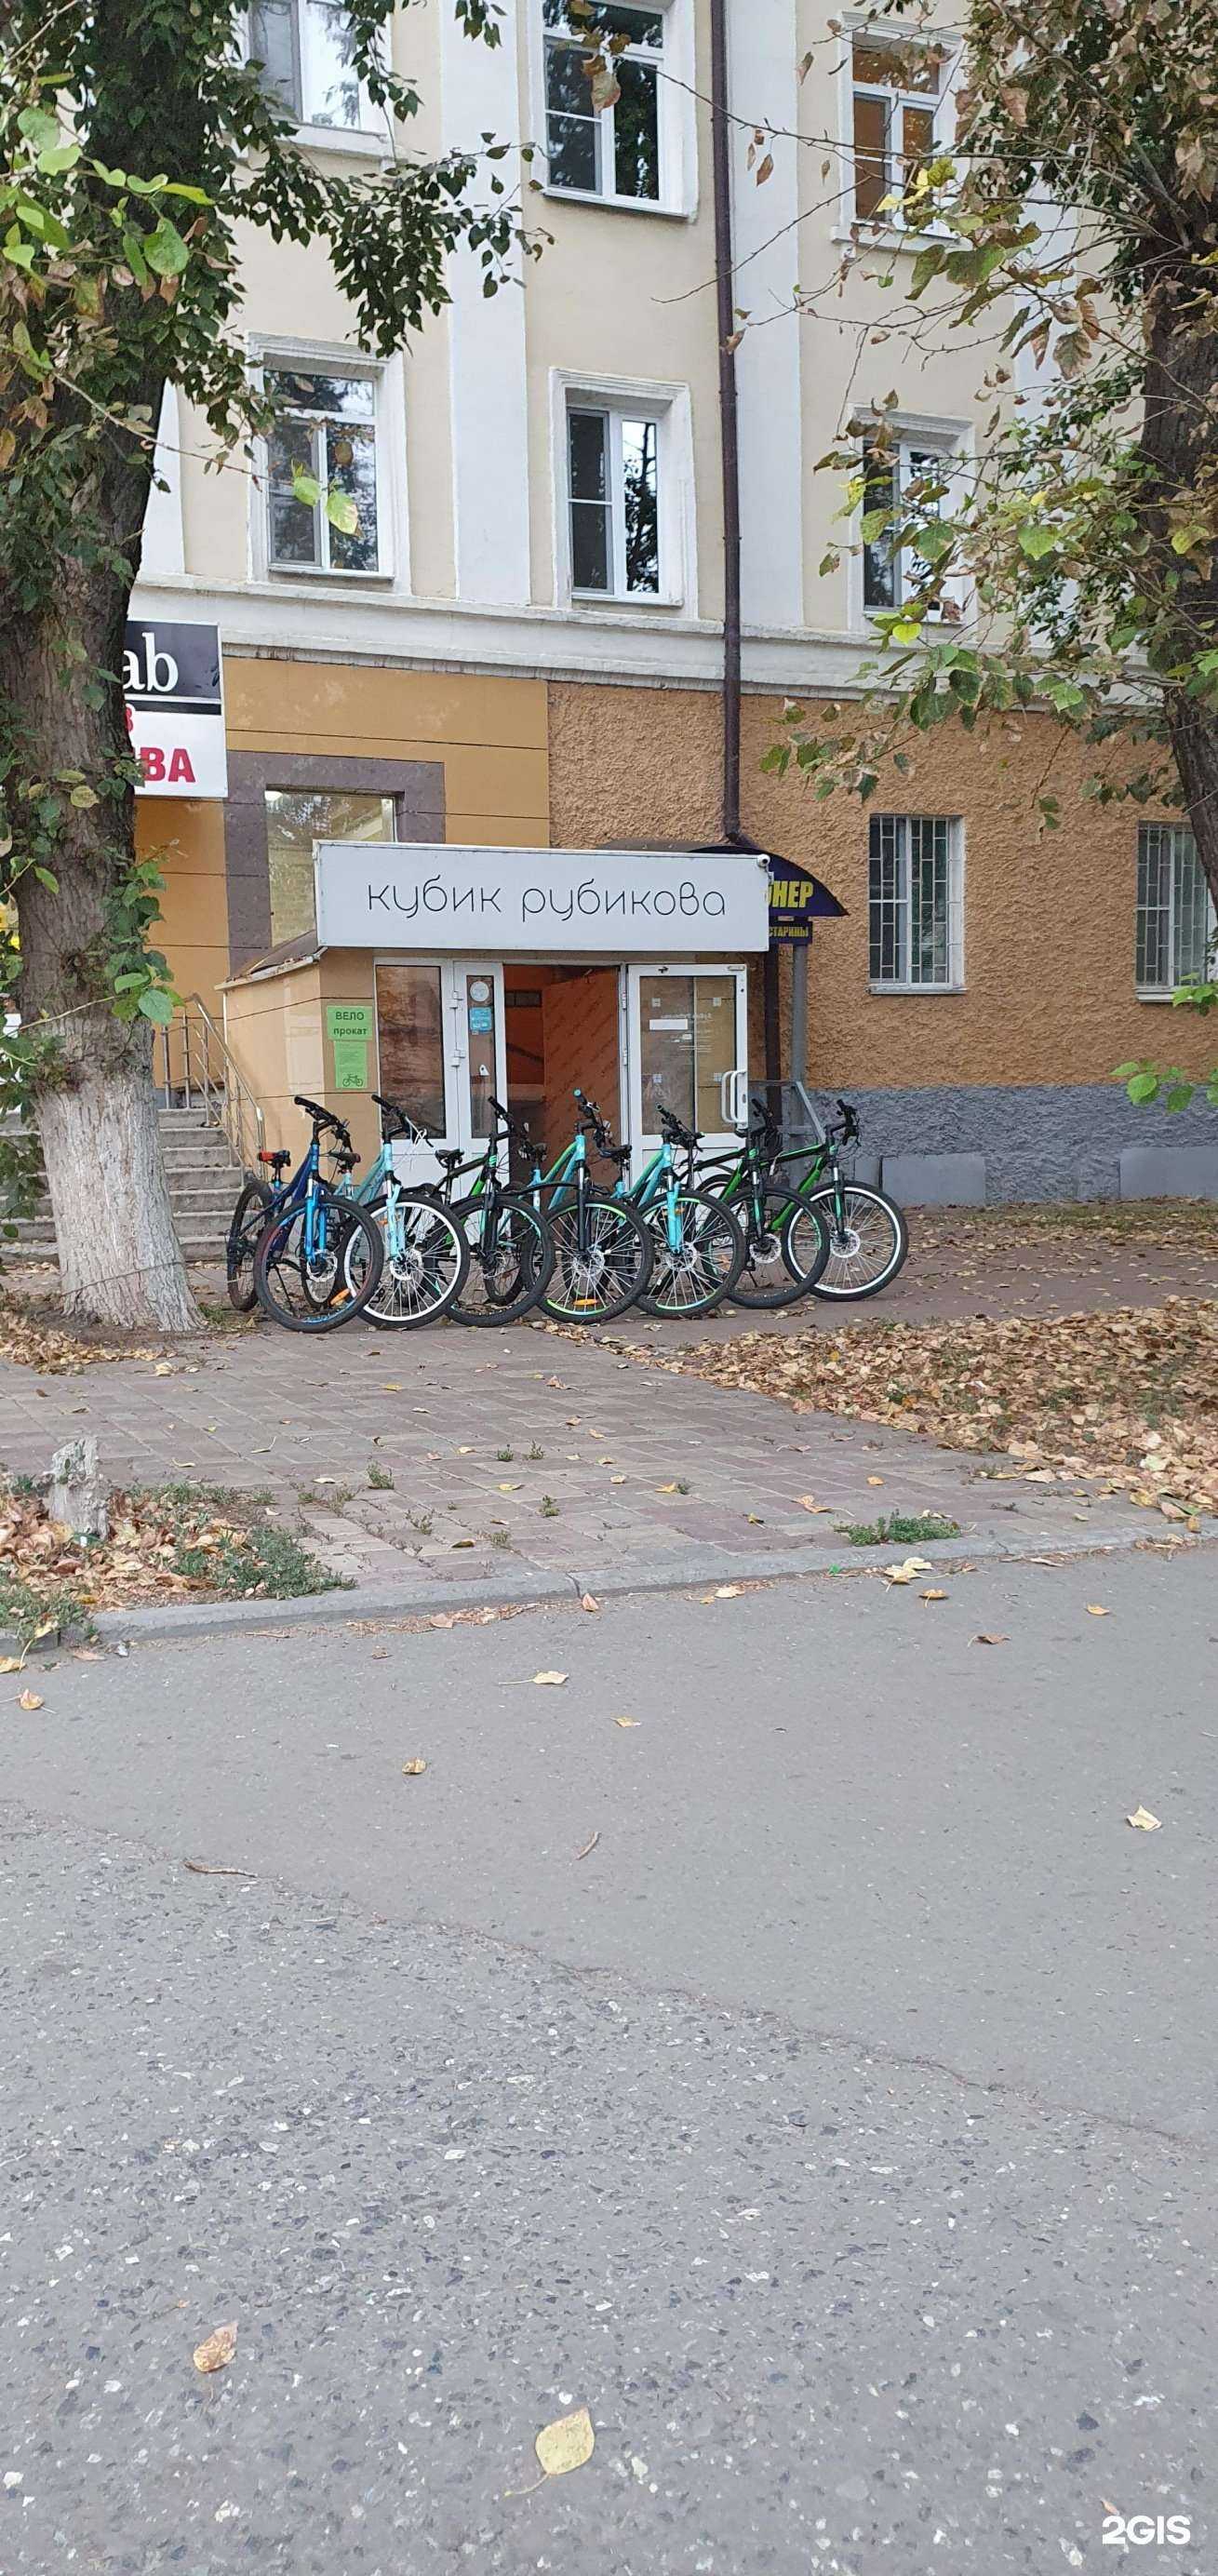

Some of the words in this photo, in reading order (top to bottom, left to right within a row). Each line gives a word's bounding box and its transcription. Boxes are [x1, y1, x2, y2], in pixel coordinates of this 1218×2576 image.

[368, 874, 502, 919] кубик
[522, 878, 726, 922] рубикова
[335, 1011, 365, 1021] ВЕЛО
[333, 1027, 368, 1038] прокат
